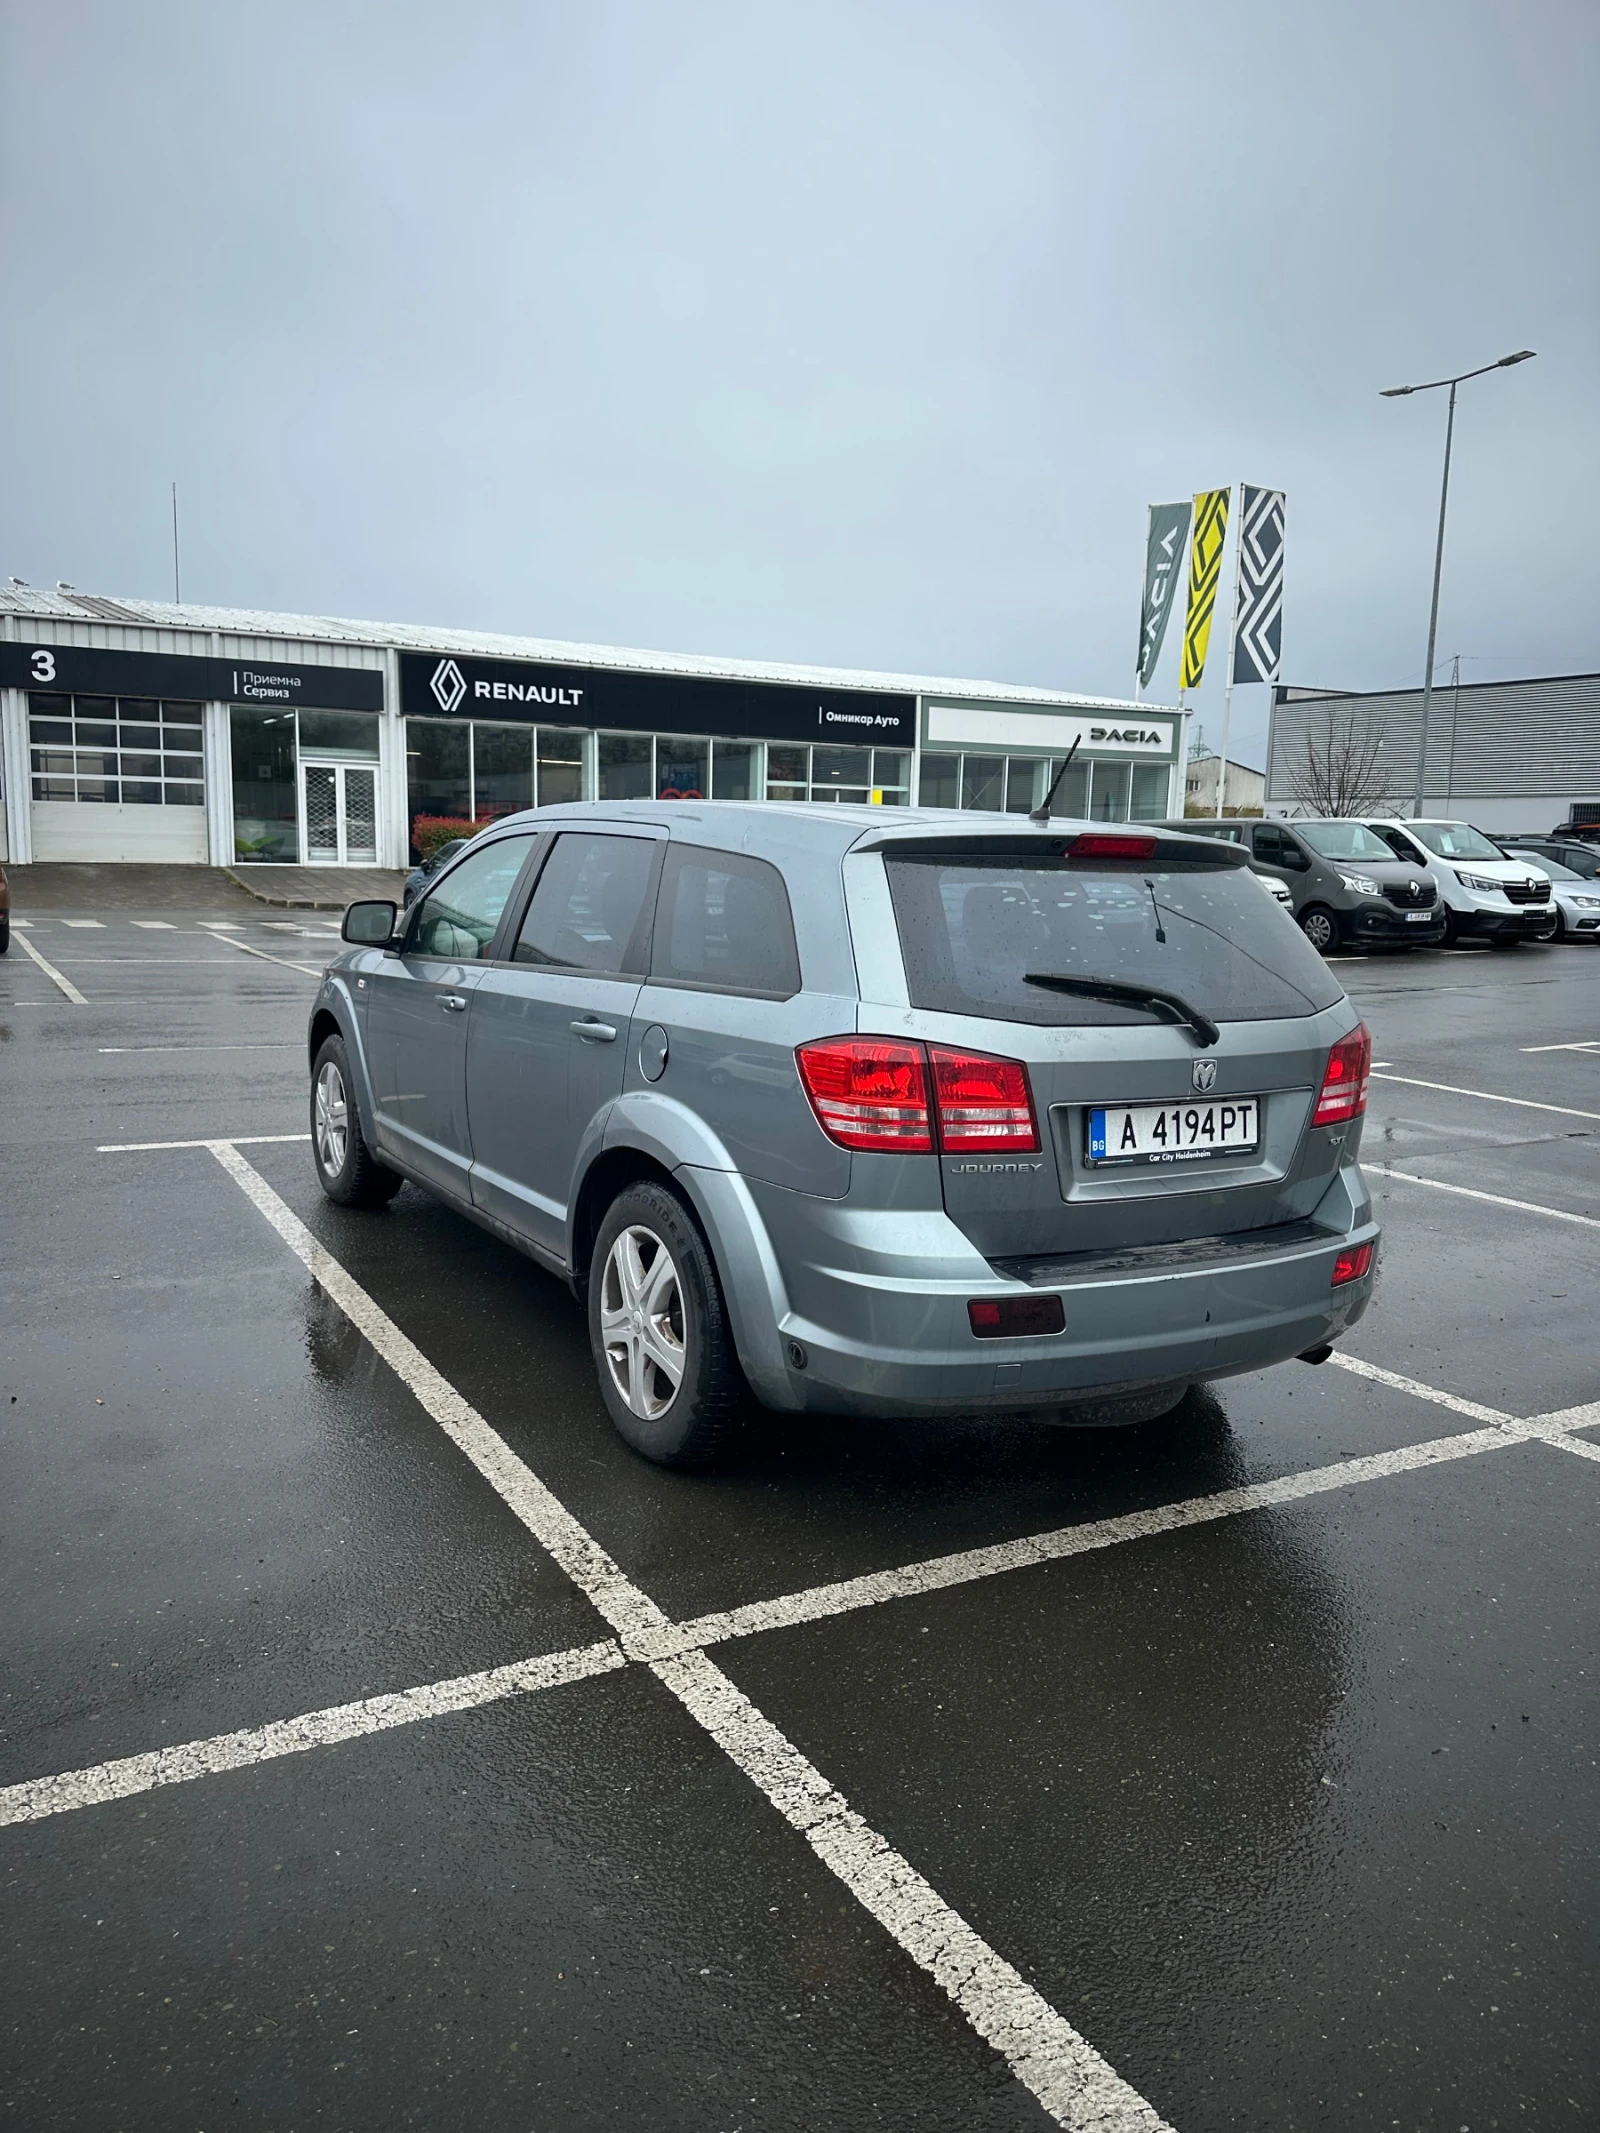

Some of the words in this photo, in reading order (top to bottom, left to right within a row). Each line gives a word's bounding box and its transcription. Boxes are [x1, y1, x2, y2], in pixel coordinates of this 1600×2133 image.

[31, 650, 56, 683] 3
[243, 671, 301, 687] Приемна
[243, 684, 289, 699] Сервиз
[474, 681, 584, 706] RENAULT
[826, 711, 874, 727] Омникар
[874, 714, 900, 728] Ауто
[1090, 727, 1162, 744] DACIA
[1120, 1113, 1137, 1150] A
[1092, 1139, 1105, 1152] BG
[1149, 1153, 1160, 1162] Car
[1161, 1152, 1174, 1163] City
[1175, 1150, 1211, 1160] Heidenheim
[951, 1163, 1043, 1174] JOURNEY
[619, 1193, 677, 1236] GOODRIDE
